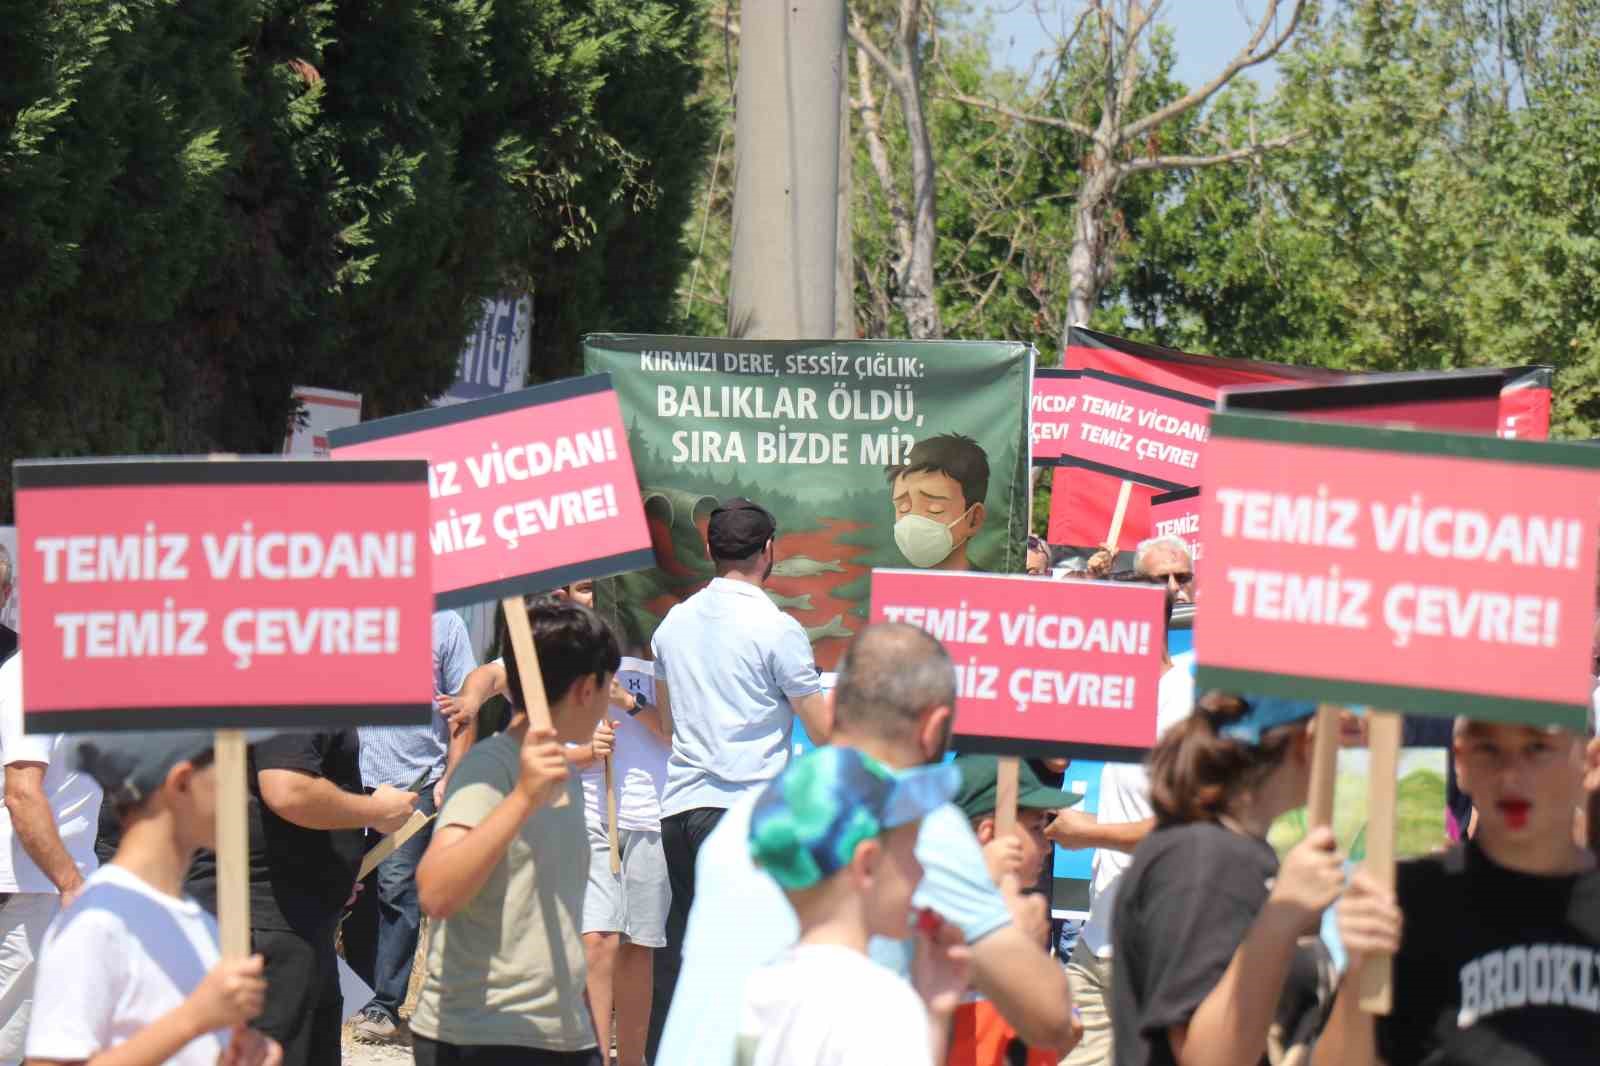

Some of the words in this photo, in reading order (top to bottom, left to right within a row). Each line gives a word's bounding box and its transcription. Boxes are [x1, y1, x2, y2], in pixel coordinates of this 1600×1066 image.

[640, 350, 718, 372] KIRMIZI
[723, 352, 780, 377] DERE,
[785, 351, 850, 376] SESSİZ
[854, 351, 925, 380] ÇIĞLIK:
[657, 384, 819, 419] BALIKLAR
[827, 381, 924, 427] ÖLDÜ,
[1081, 394, 1135, 423] TEMİZ
[1138, 408, 1210, 442] VİCDAN!
[464, 427, 618, 489] VİCDAN!
[671, 430, 747, 464] SIRA
[757, 424, 849, 465] BİZDE
[860, 426, 915, 466] Mİ?
[1080, 422, 1134, 452] TEMİZ
[1135, 437, 1200, 469] ÇEVRE!
[492, 483, 619, 550] ÇEVRE!
[1154, 512, 1200, 537] TEMİZ
[1214, 485, 1360, 549] TEMİZ
[1370, 494, 1582, 570] VİCDAN!
[34, 521, 190, 584] TEMİZ
[201, 521, 416, 580] VİCDAN!
[998, 604, 1152, 656] VİCDAN!
[1226, 563, 1372, 629] TEMİZ
[1382, 582, 1560, 648] ÇEVRE!
[54, 597, 209, 660] TEMİZ
[221, 606, 400, 669] ÇEVRE!
[1007, 667, 1137, 712] ÇEVRE!
